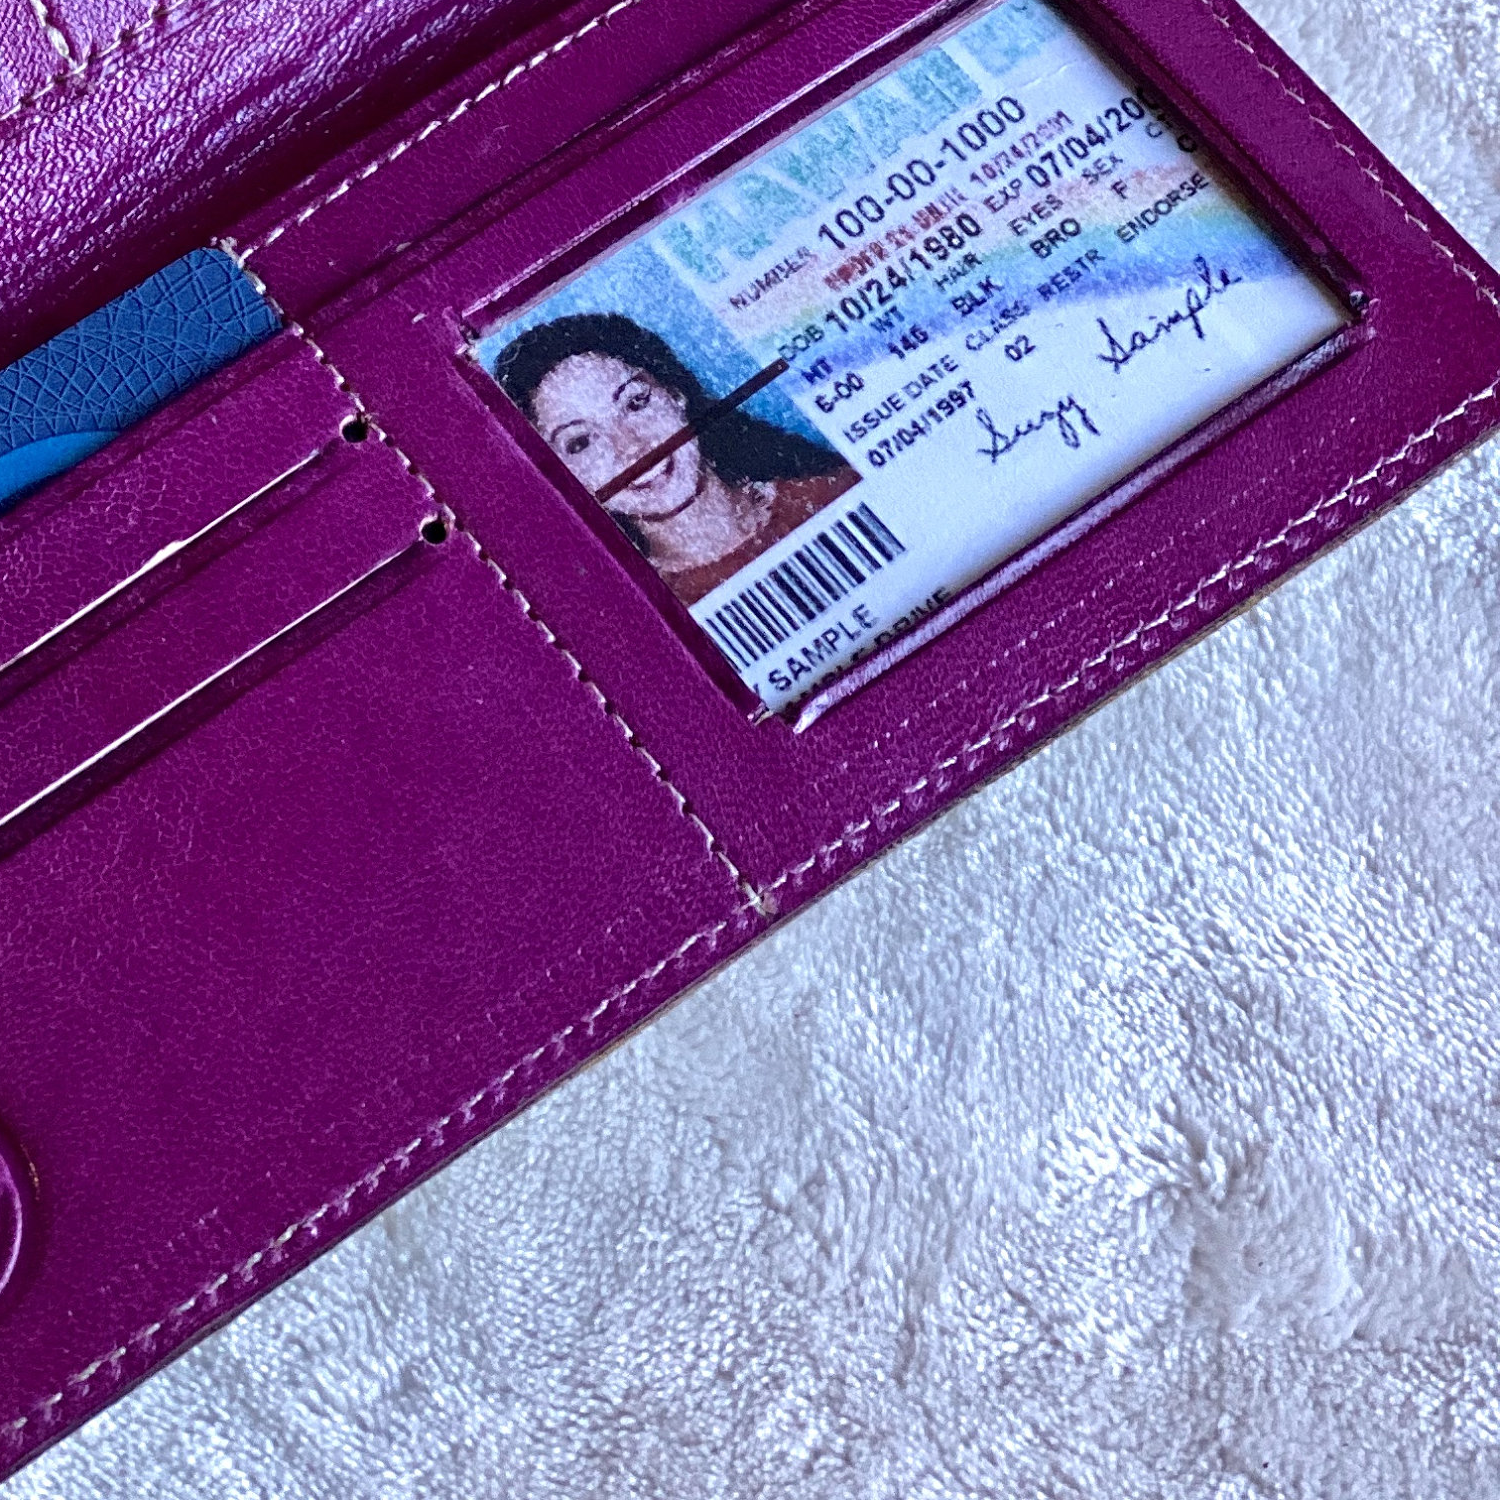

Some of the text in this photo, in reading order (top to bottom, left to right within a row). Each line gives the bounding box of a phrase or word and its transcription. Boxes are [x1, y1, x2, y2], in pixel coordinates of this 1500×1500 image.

[817, 95, 1027, 250] 100-00-1000
[1008, 194, 1064, 237] EYES
[1030, 217, 1082, 259] BRO
[1110, 179, 1129, 200] F
[826, 212, 984, 333] 10/24/1980
[983, 178, 1023, 214] EXP
[843, 392, 907, 443] ISSUE
[902, 354, 959, 399] DATE
[1037, 248, 1106, 301] RESTR
[1115, 171, 1210, 243] ENDORSE
[1004, 334, 1037, 362] 02
[1096, 254, 1243, 374] Sample
[768, 604, 878, 692] SAMPLE
